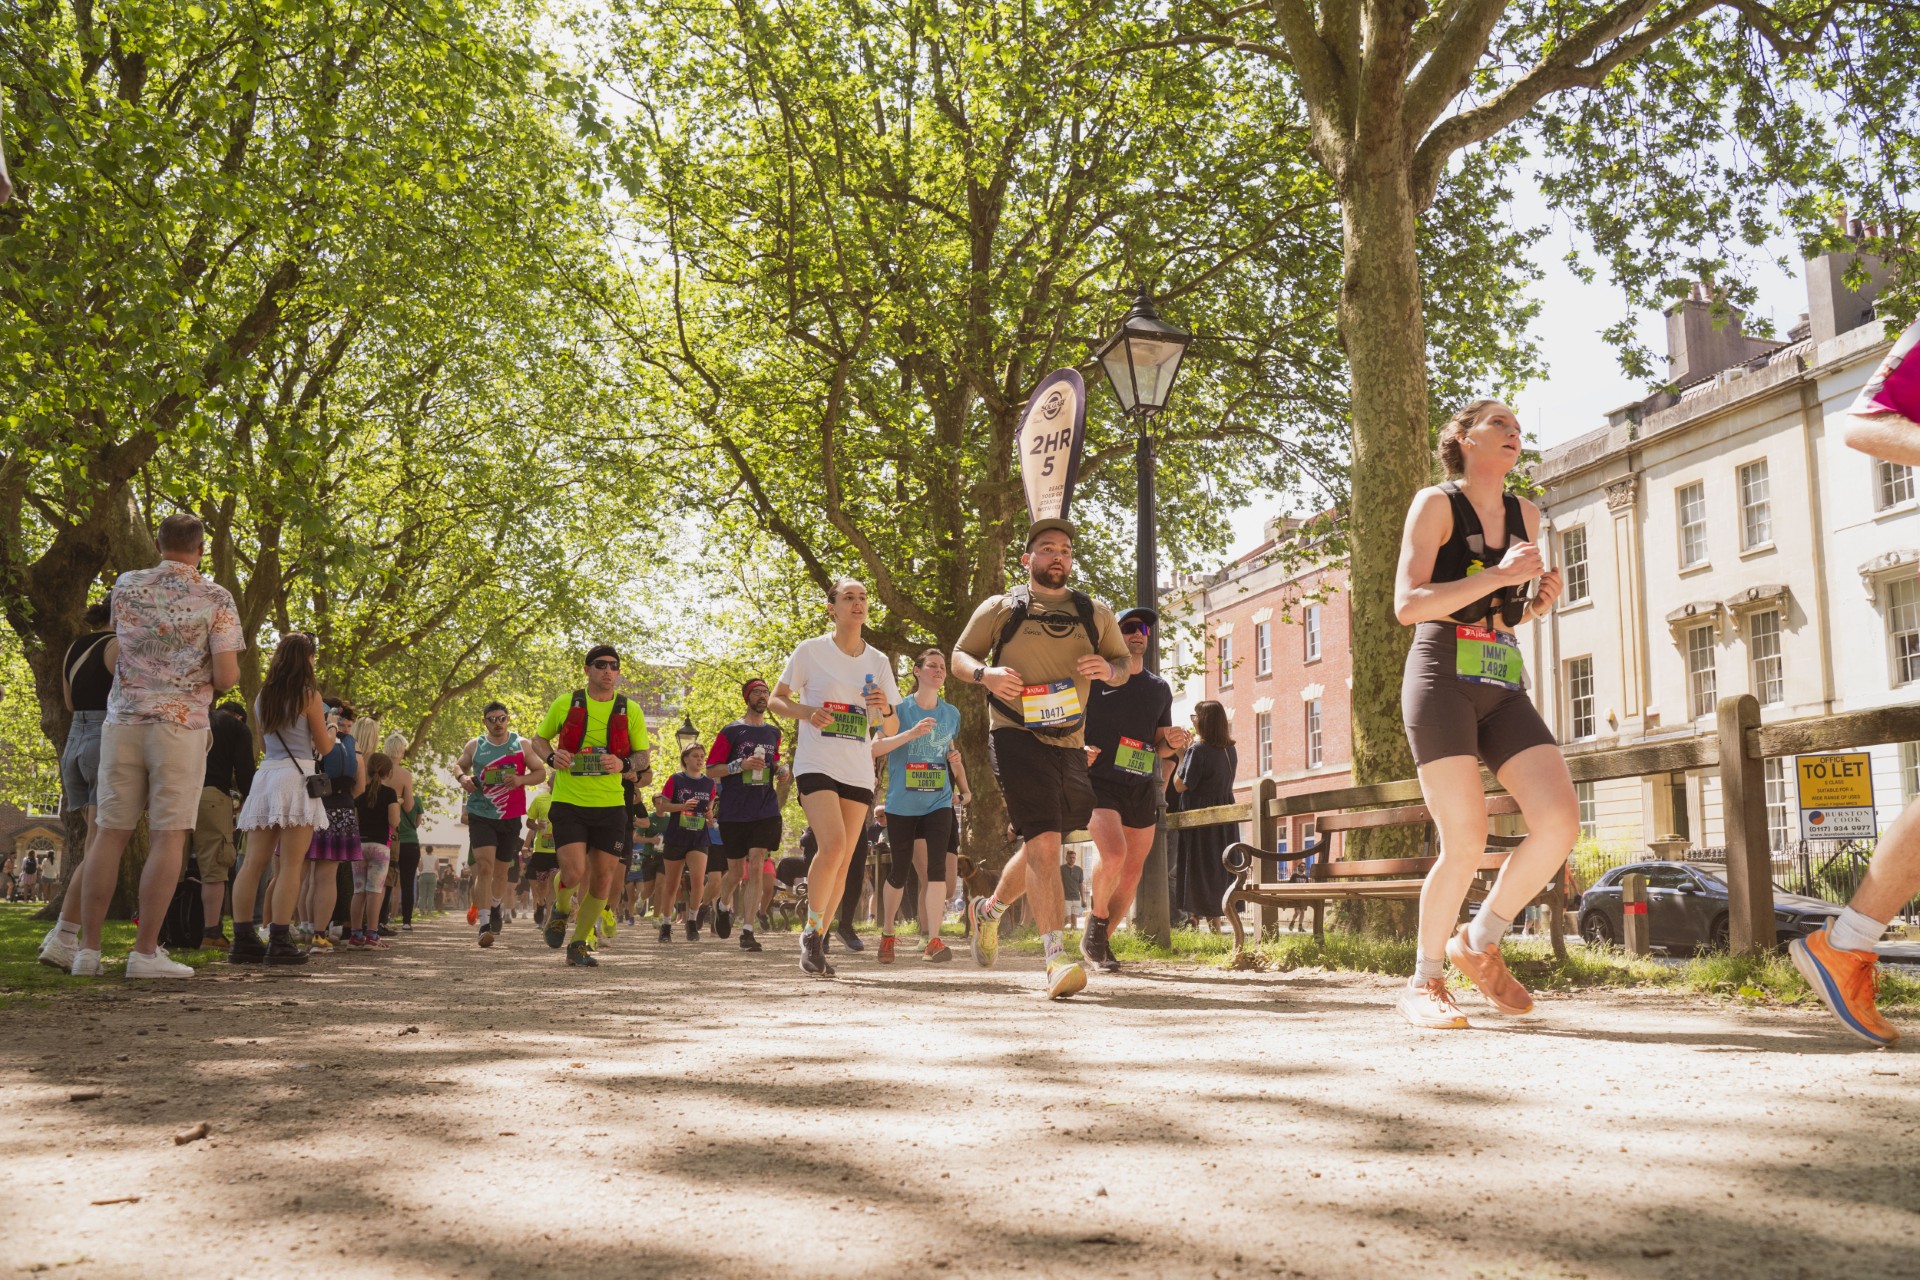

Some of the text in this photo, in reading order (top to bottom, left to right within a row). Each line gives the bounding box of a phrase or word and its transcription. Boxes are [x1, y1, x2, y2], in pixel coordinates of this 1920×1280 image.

[1030, 428, 1071, 455] 2HR
[1041, 456, 1055, 476] 5
[1023, 626, 1042, 636] Since
[1482, 645, 1507, 662] IMMY
[1480, 660, 1508, 678] 14828
[1040, 706, 1066, 719] 10471
[836, 722, 858, 734] 17274
[1820, 756, 1845, 764] OFFICE
[911, 771, 941, 779] CHARLOTTE
[1803, 762, 1863, 779] TO LET
